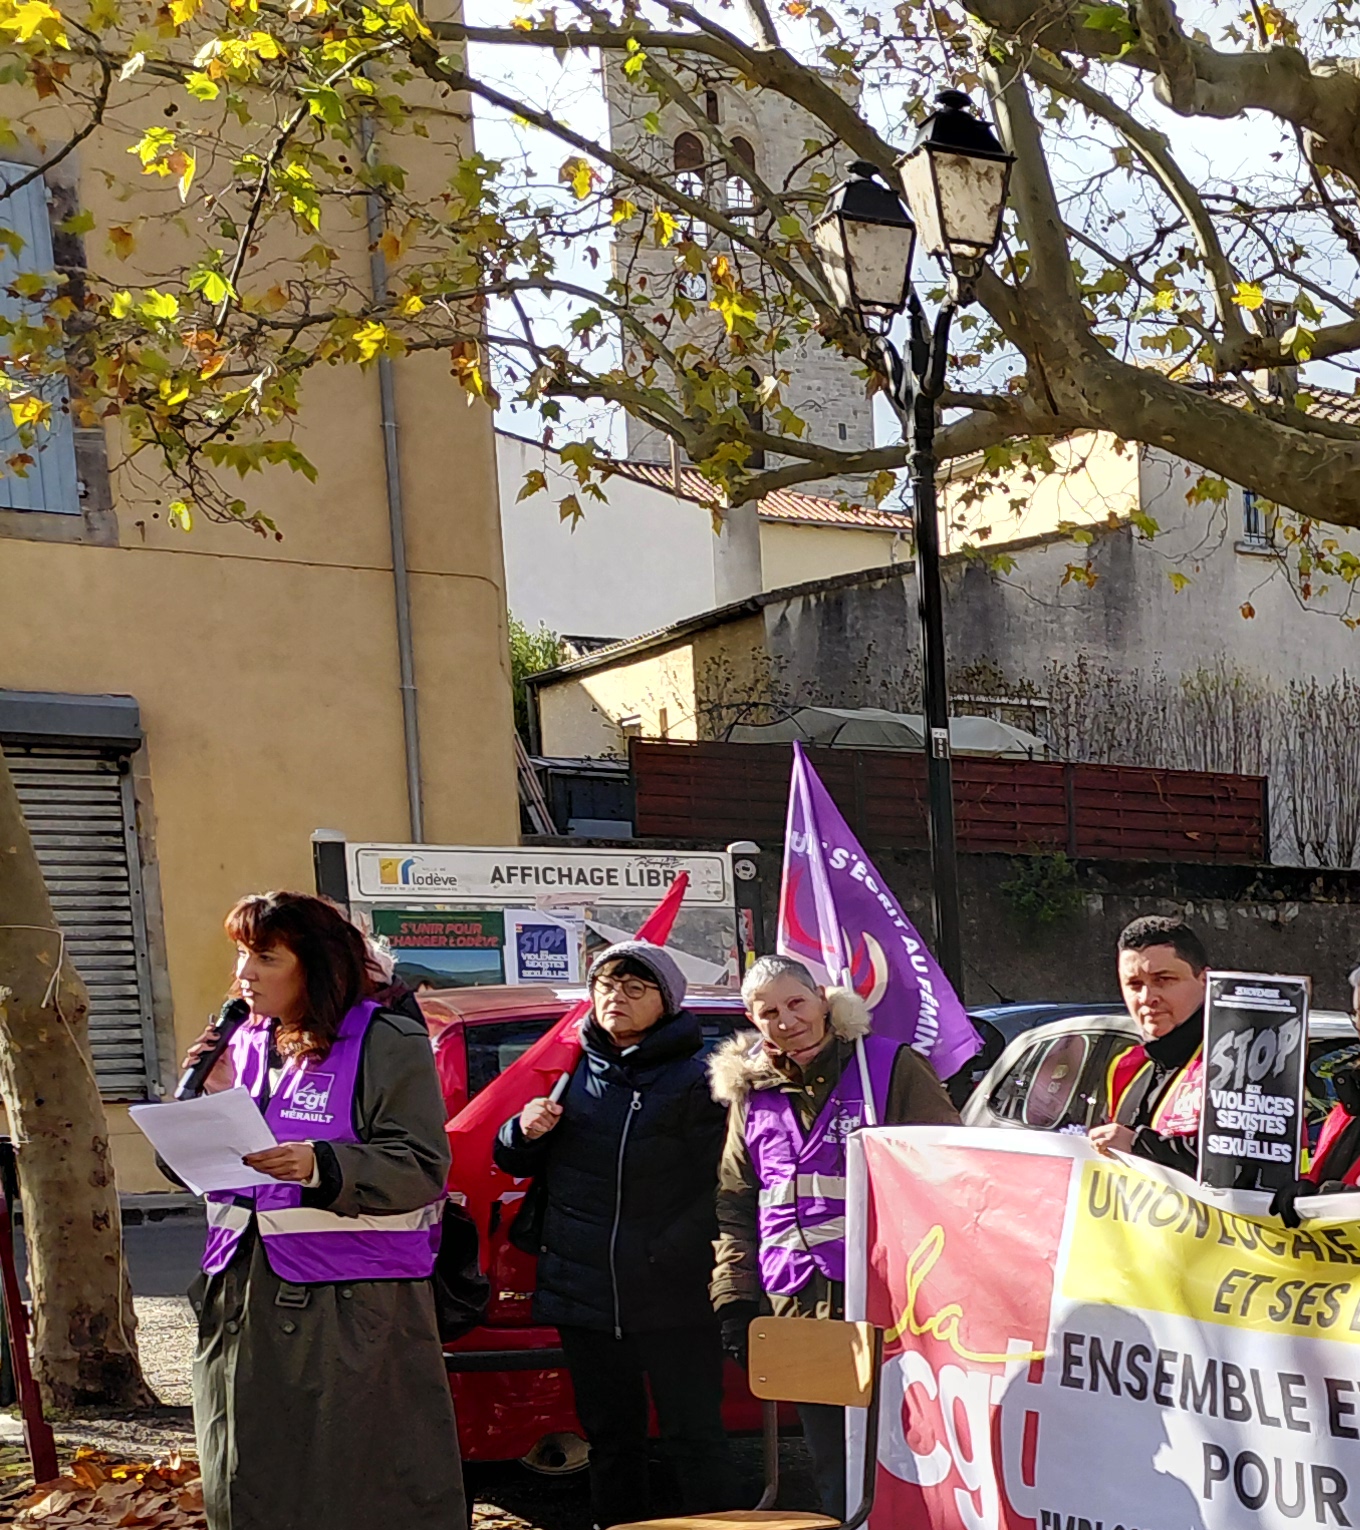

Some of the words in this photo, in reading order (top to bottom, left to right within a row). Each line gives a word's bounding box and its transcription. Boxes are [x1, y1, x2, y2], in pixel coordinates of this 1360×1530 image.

[412, 872, 457, 885] lodève
[490, 865, 619, 886] AFFICHAGE
[829, 847, 909, 930] S'ÉCRIT
[901, 935, 929, 973] AU
[401, 922, 443, 934] S'UNIR
[445, 923, 482, 934] POUR
[520, 929, 565, 952] STOP
[1209, 1015, 1301, 1091] STOP
[293, 1090, 329, 1111] cgt
[1211, 1090, 1295, 1117] VIOLENCES
[280, 1109, 334, 1124] HÉRAULT
[1215, 1109, 1287, 1135] SEXISTES
[1207, 1134, 1292, 1163] SEXUELLES
[1088, 1170, 1208, 1238] UNION
[883, 1224, 1044, 1363] la
[1213, 1269, 1277, 1317] ET
[1268, 1280, 1350, 1328] SES
[1061, 1332, 1311, 1433] ENSEMBLE
[1202, 1442, 1352, 1528] POUR
